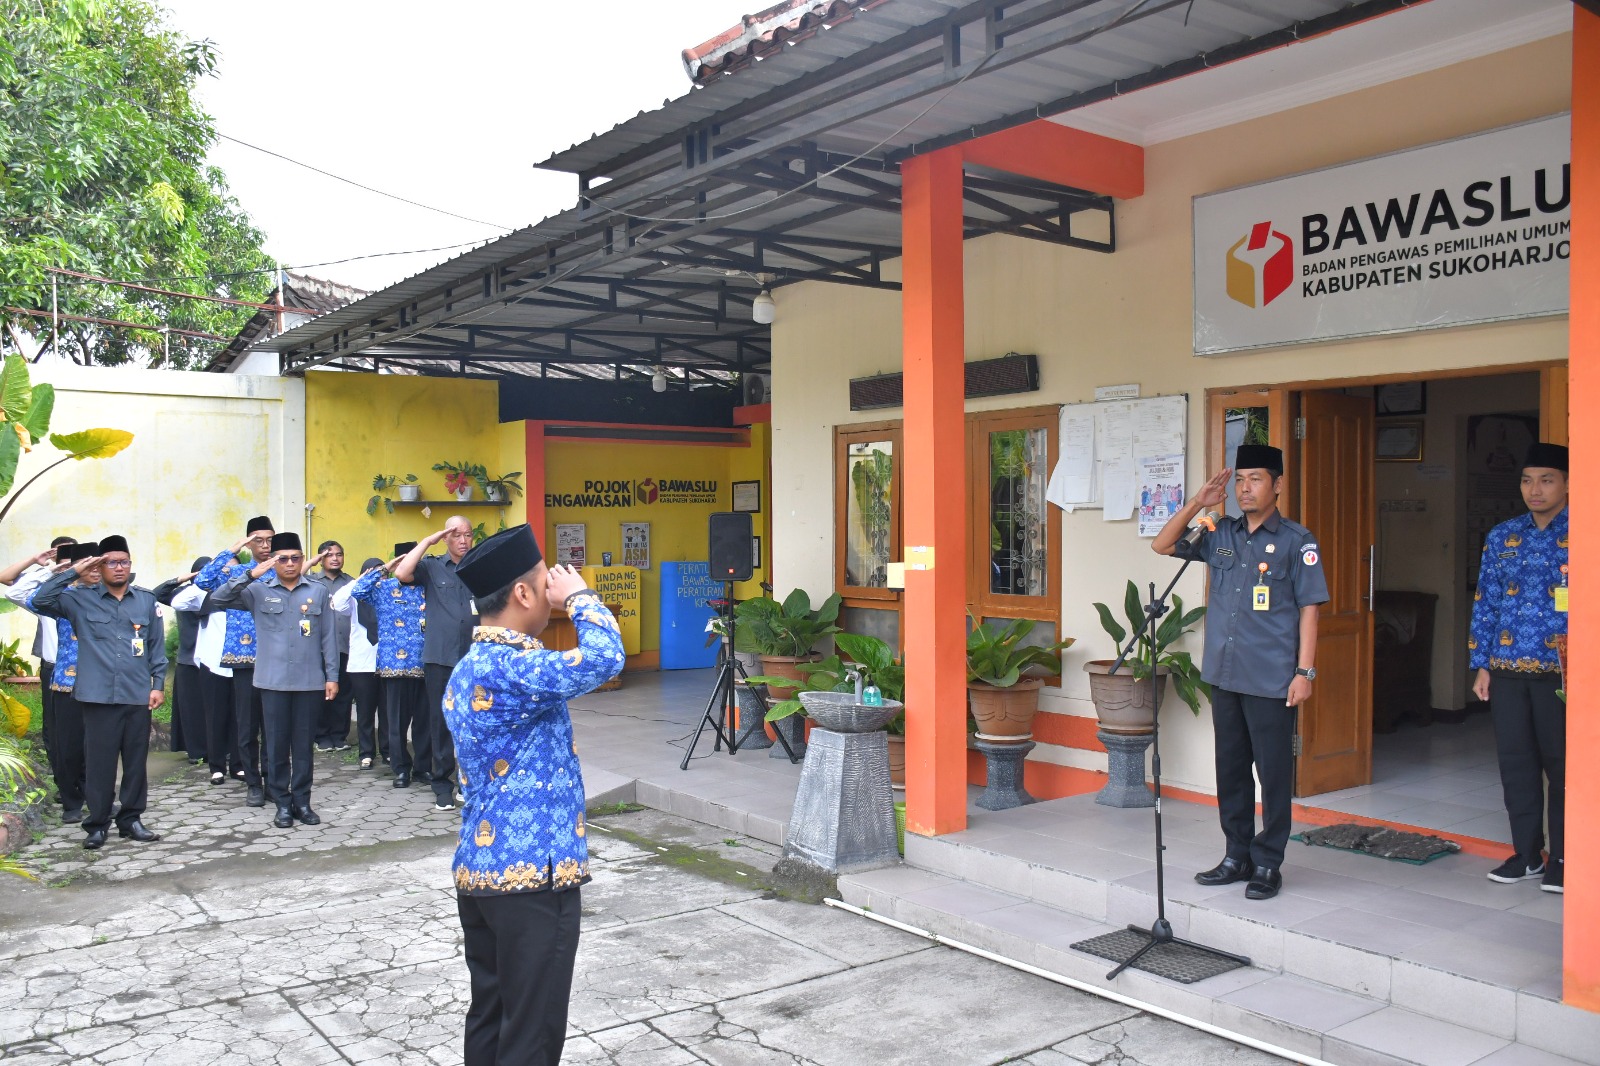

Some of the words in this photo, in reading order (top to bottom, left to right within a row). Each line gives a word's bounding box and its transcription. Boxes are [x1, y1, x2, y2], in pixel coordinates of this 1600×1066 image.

[1302, 163, 1570, 256] BAWASLU
[1302, 258, 1346, 277] BADAN
[1350, 244, 1429, 268] PENGAWAS
[1434, 229, 1517, 256] PEMILIHAN
[1522, 219, 1570, 241] UMUM
[1302, 263, 1422, 298] KABUPATEN
[1428, 240, 1570, 279] SUKOHARJO
[584, 480, 631, 493] POJOK
[659, 479, 717, 492] BAWASLU
[625, 548, 648, 561] ASN
[595, 571, 637, 583] UNDANG
[596, 581, 637, 593] UNDANG
[677, 586, 724, 598] PERATURAN
[604, 591, 637, 603] PEMILU
